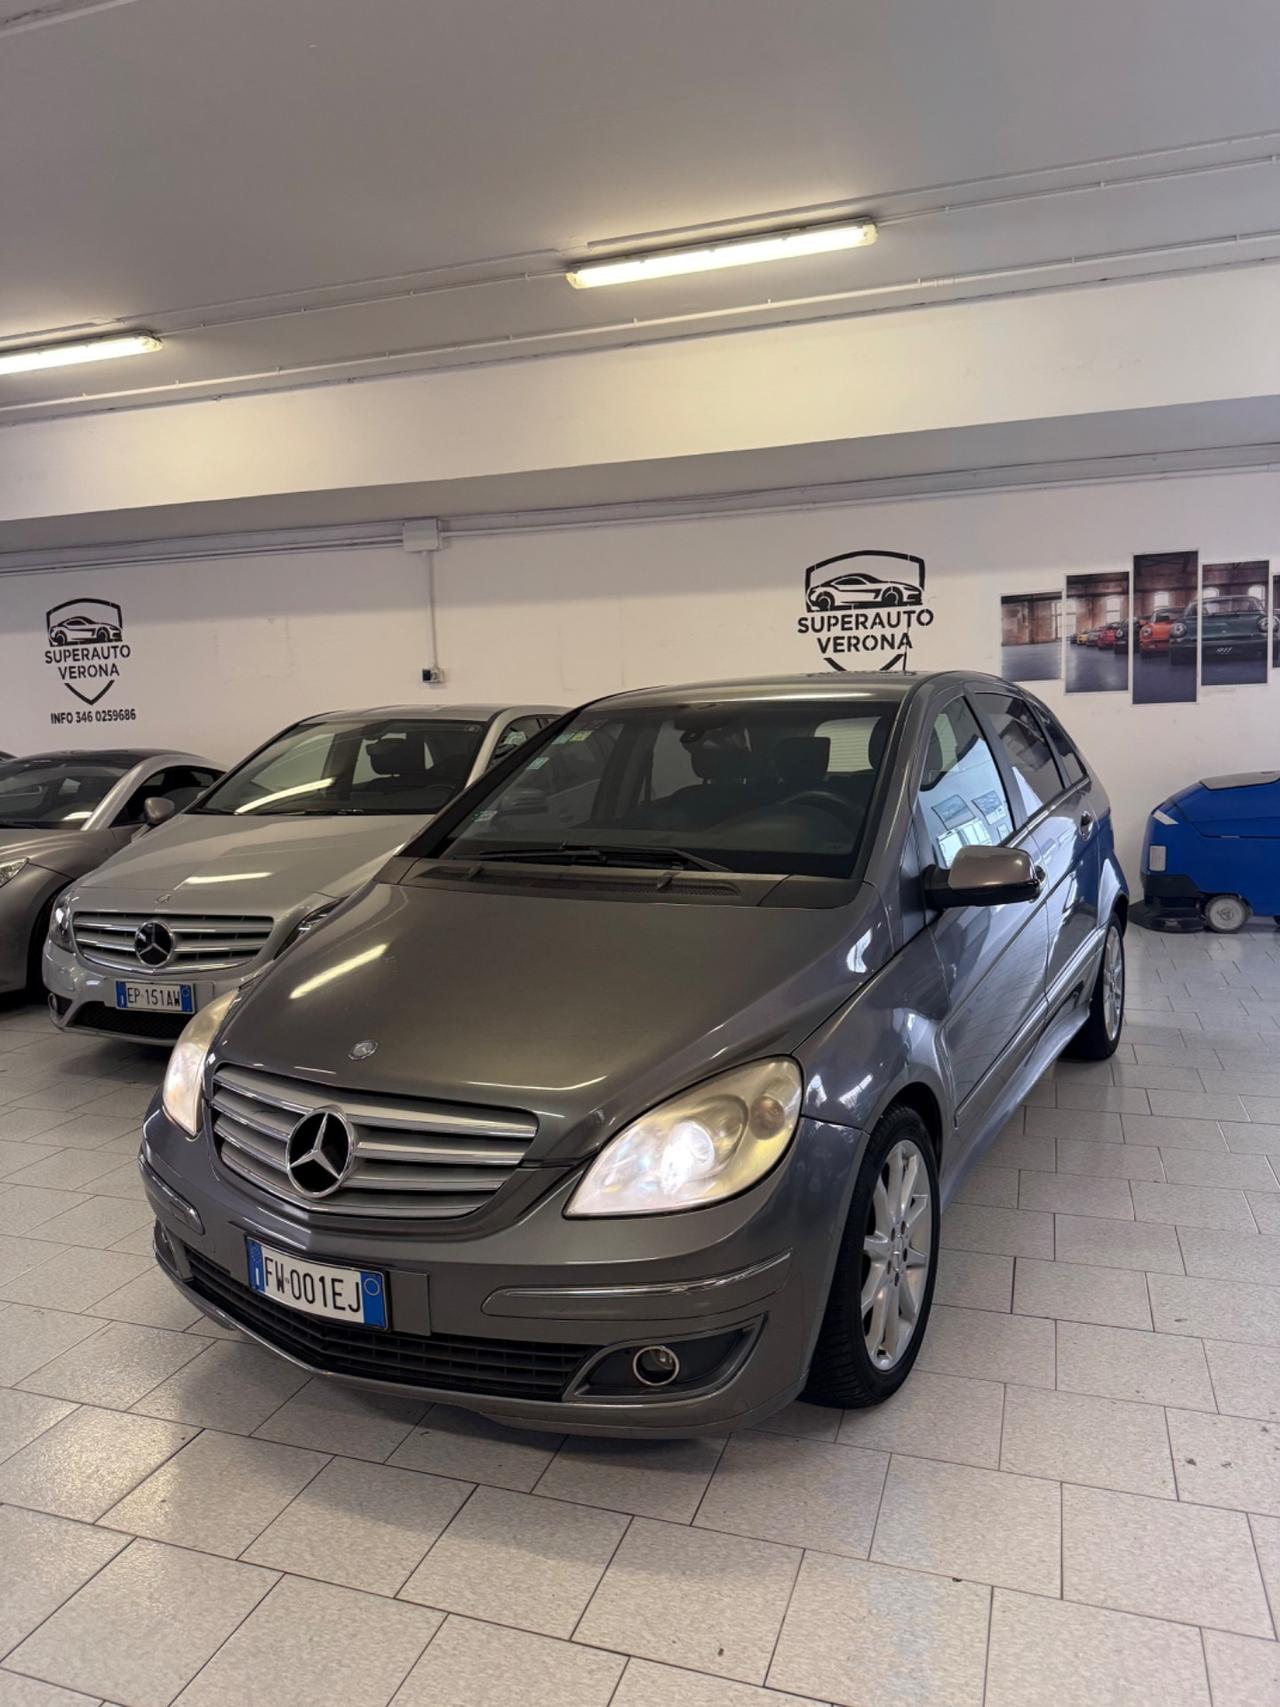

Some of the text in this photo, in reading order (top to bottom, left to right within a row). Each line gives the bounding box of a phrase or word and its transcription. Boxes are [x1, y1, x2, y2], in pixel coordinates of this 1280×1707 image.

[797, 609, 934, 633] SUPERAUTO
[817, 633, 913, 654] VERONA
[45, 645, 131, 664] SUPERAUTO
[58, 663, 120, 680] VERONA
[50, 709, 136, 724] INFO 346 0259686
